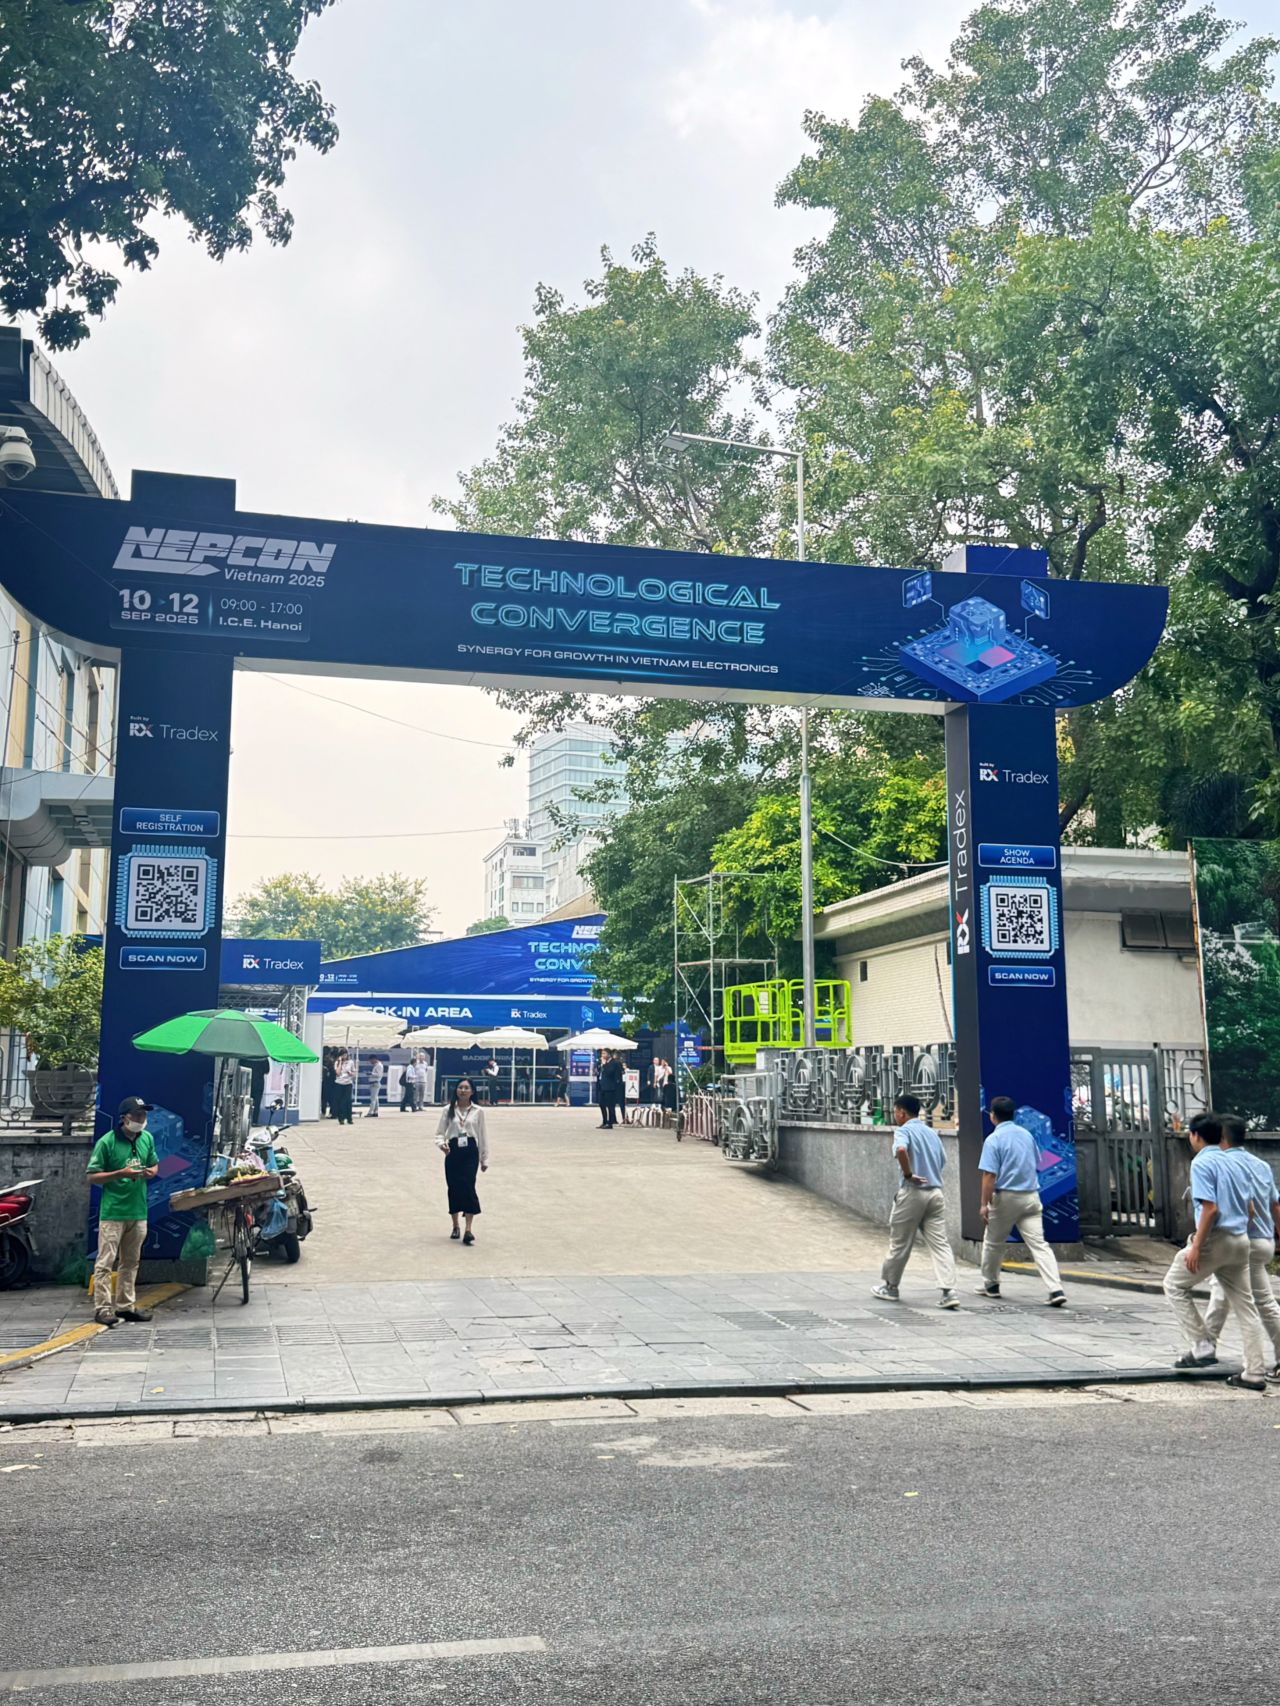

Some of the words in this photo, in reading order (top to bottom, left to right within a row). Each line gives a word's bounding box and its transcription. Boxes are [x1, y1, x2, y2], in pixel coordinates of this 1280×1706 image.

[112, 526, 337, 576] NEPCON
[224, 568, 284, 584] Vietnam
[288, 574, 326, 588] 2025
[454, 563, 781, 609] TECHNOLOGICAL
[118, 589, 152, 611] 10
[169, 592, 199, 614] 12
[221, 598, 257, 612] 09:00
[269, 602, 303, 615] 17:00
[121, 611, 151, 621] SEP
[155, 614, 198, 625] 2025
[219, 617, 257, 628] I.C.E.
[261, 620, 302, 632] Hanoi
[471, 603, 766, 644] CONVERGENCE
[457, 644, 522, 657] SYNERGY
[525, 649, 551, 658] FOR
[554, 651, 614, 663] GROWTH
[616, 655, 629, 664] IN
[631, 656, 690, 668] VIETNAM
[692, 660, 779, 674] ELECTRONICS
[160, 724, 218, 741] Tradex
[1002, 769, 1049, 784] Tradex
[159, 813, 183, 822] SELF
[136, 821, 204, 832] REGISTRATION
[953, 789, 969, 901] Tradex
[1003, 848, 1030, 856] SHOW
[1000, 856, 1035, 865] AGENDA
[128, 954, 164, 962] SCAN
[167, 955, 198, 963] NOW
[263, 958, 304, 970] Tradex
[994, 972, 1023, 980] SCAN
[424, 1006, 473, 1018] AREA
[523, 1010, 548, 1019] Tradex
